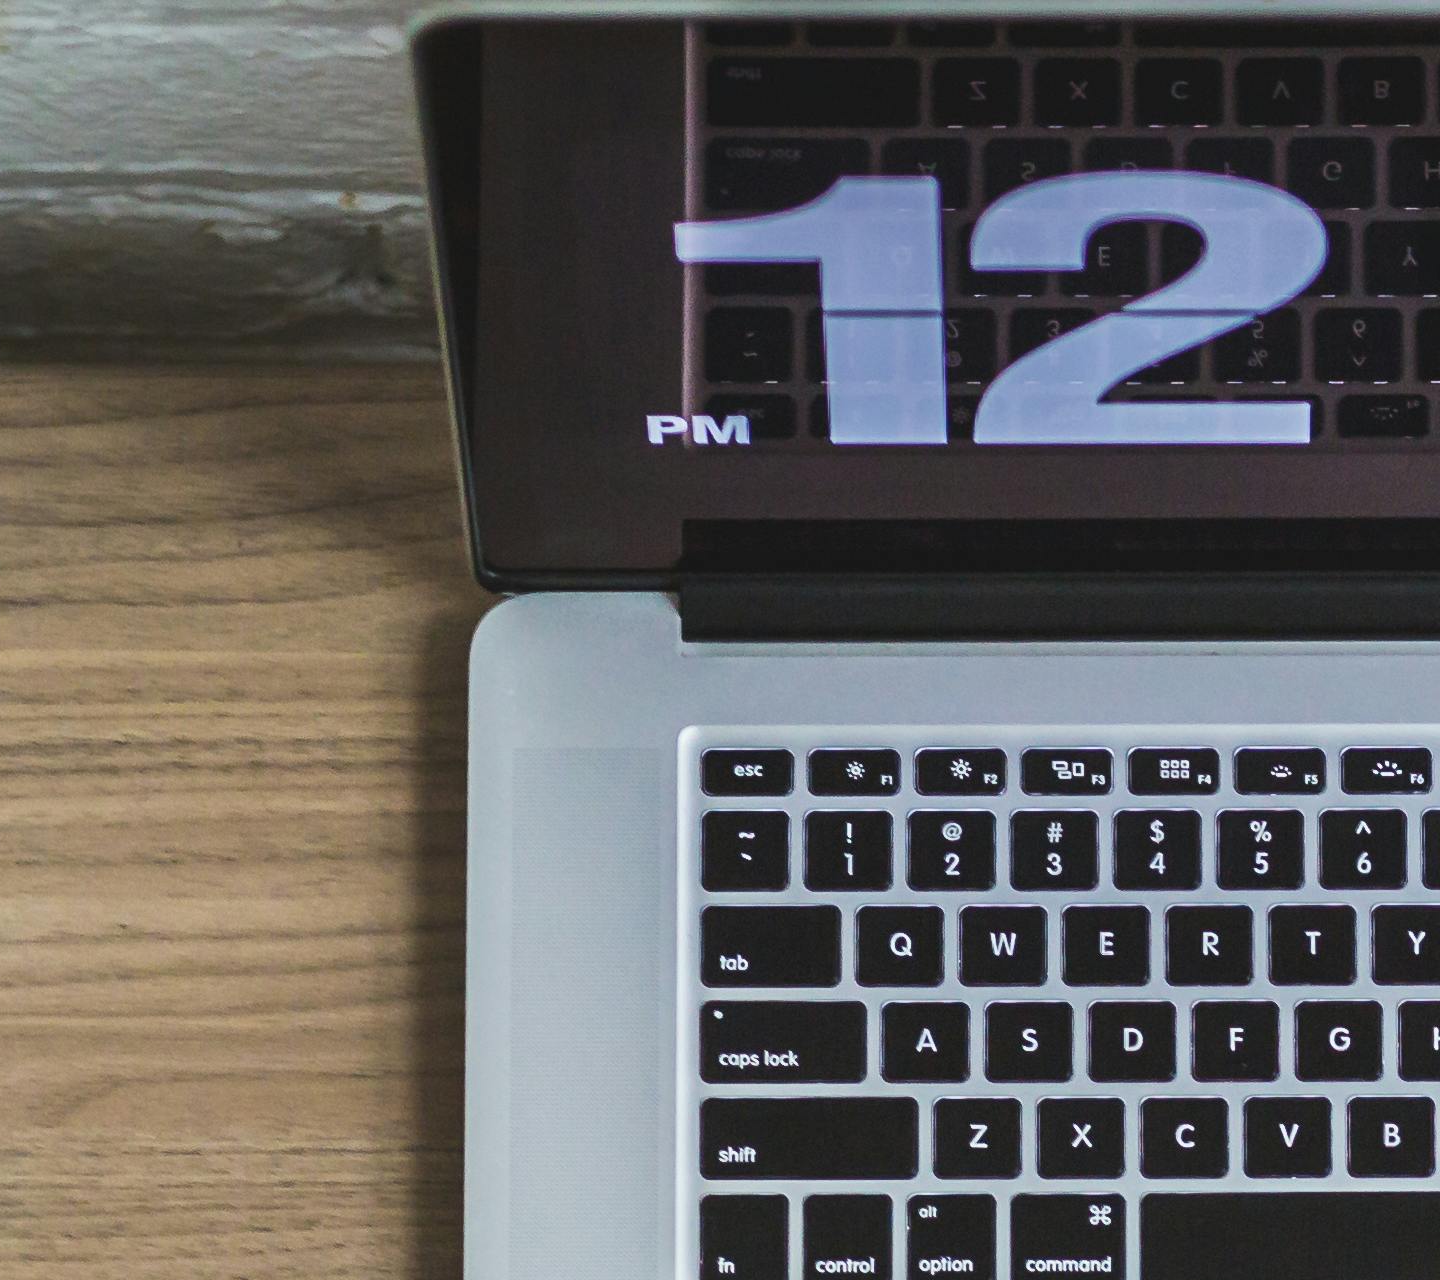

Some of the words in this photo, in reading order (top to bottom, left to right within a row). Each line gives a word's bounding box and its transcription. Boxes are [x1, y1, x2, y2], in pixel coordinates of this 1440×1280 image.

[673, 168, 1331, 446] 12
[645, 414, 751, 445] PM
[733, 764, 763, 777] esc
[983, 773, 998, 785] F2
[1091, 774, 1106, 786] F3
[1197, 774, 1212, 785] F4
[1304, 773, 1319, 785] F5
[1409, 773, 1425, 785] F6
[843, 852, 854, 876] 1
[944, 852, 961, 876] 2
[1046, 852, 1063, 876] 3
[1149, 851, 1166, 875] 4
[1253, 851, 1269, 875] 5
[1356, 851, 1372, 875] 6
[719, 954, 749, 971] tab
[889, 932, 913, 957] Q
[989, 932, 1017, 957] W
[1099, 931, 1115, 956] E
[1202, 931, 1220, 956] R
[1304, 930, 1322, 955] T
[1407, 930, 1426, 955] Y
[718, 1053, 760, 1070] caps
[763, 1049, 799, 1067] lock
[915, 1027, 938, 1053] A
[1022, 1028, 1039, 1052] S
[1123, 1027, 1144, 1052] D
[1229, 1027, 1245, 1052] F
[1328, 1026, 1351, 1052] G
[718, 1146, 757, 1163] shift
[969, 1123, 989, 1149] Z
[1071, 1123, 1093, 1148] X
[1175, 1123, 1196, 1149] C
[1278, 1123, 1300, 1148] V
[1383, 1122, 1401, 1148] B
[918, 1205, 938, 1219] alt
[717, 1256, 736, 1274] fn
[815, 1256, 876, 1274] control
[918, 1256, 974, 1276] option
[1025, 1255, 1112, 1273] command
